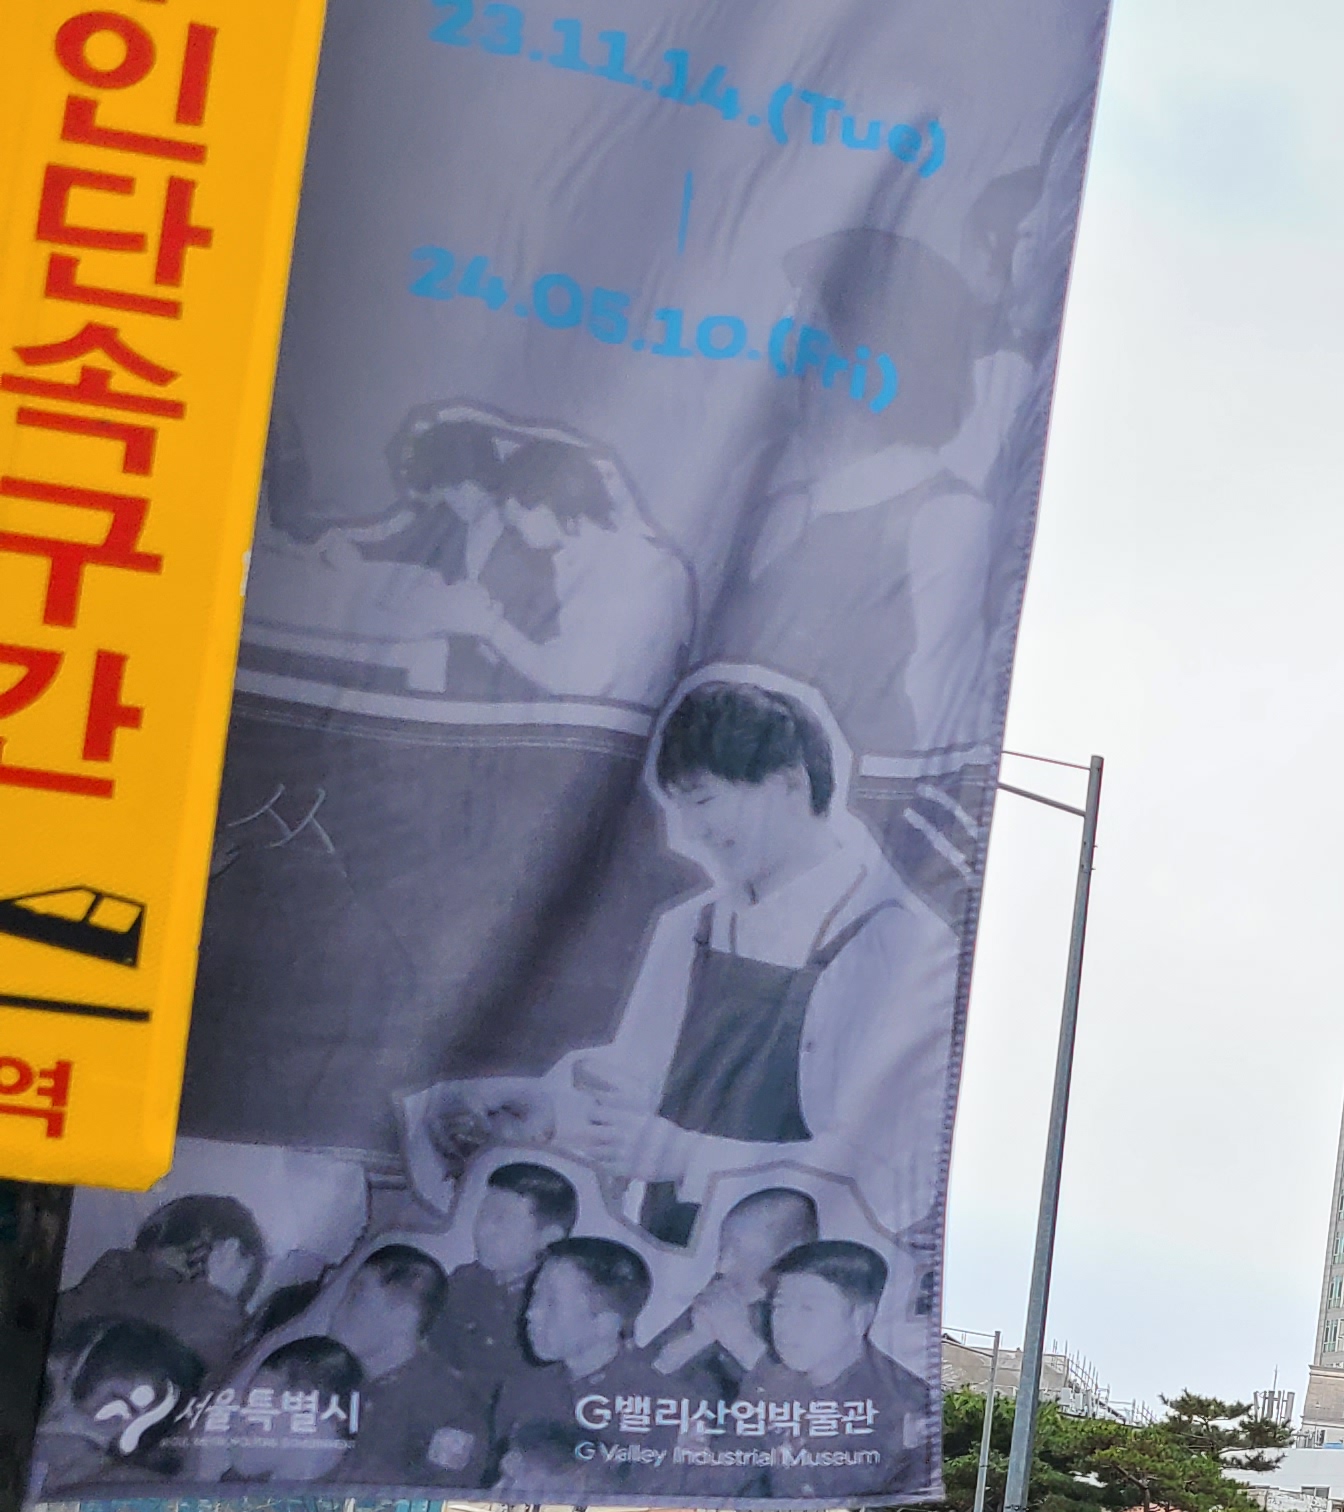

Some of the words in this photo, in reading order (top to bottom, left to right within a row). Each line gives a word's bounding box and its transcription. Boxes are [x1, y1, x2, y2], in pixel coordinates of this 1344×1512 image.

[408, 244, 898, 414] 24.05.10.(Fri)
[0, 0, 218, 798] 인단속구간
[174, 1386, 361, 1434] 서울특별시
[574, 1394, 880, 1437] G밸리산업박물관
[575, 1441, 596, 1461] G
[600, 1443, 667, 1467] Valley
[673, 1446, 776, 1466] Industrial
[783, 1446, 881, 1468] Museum
